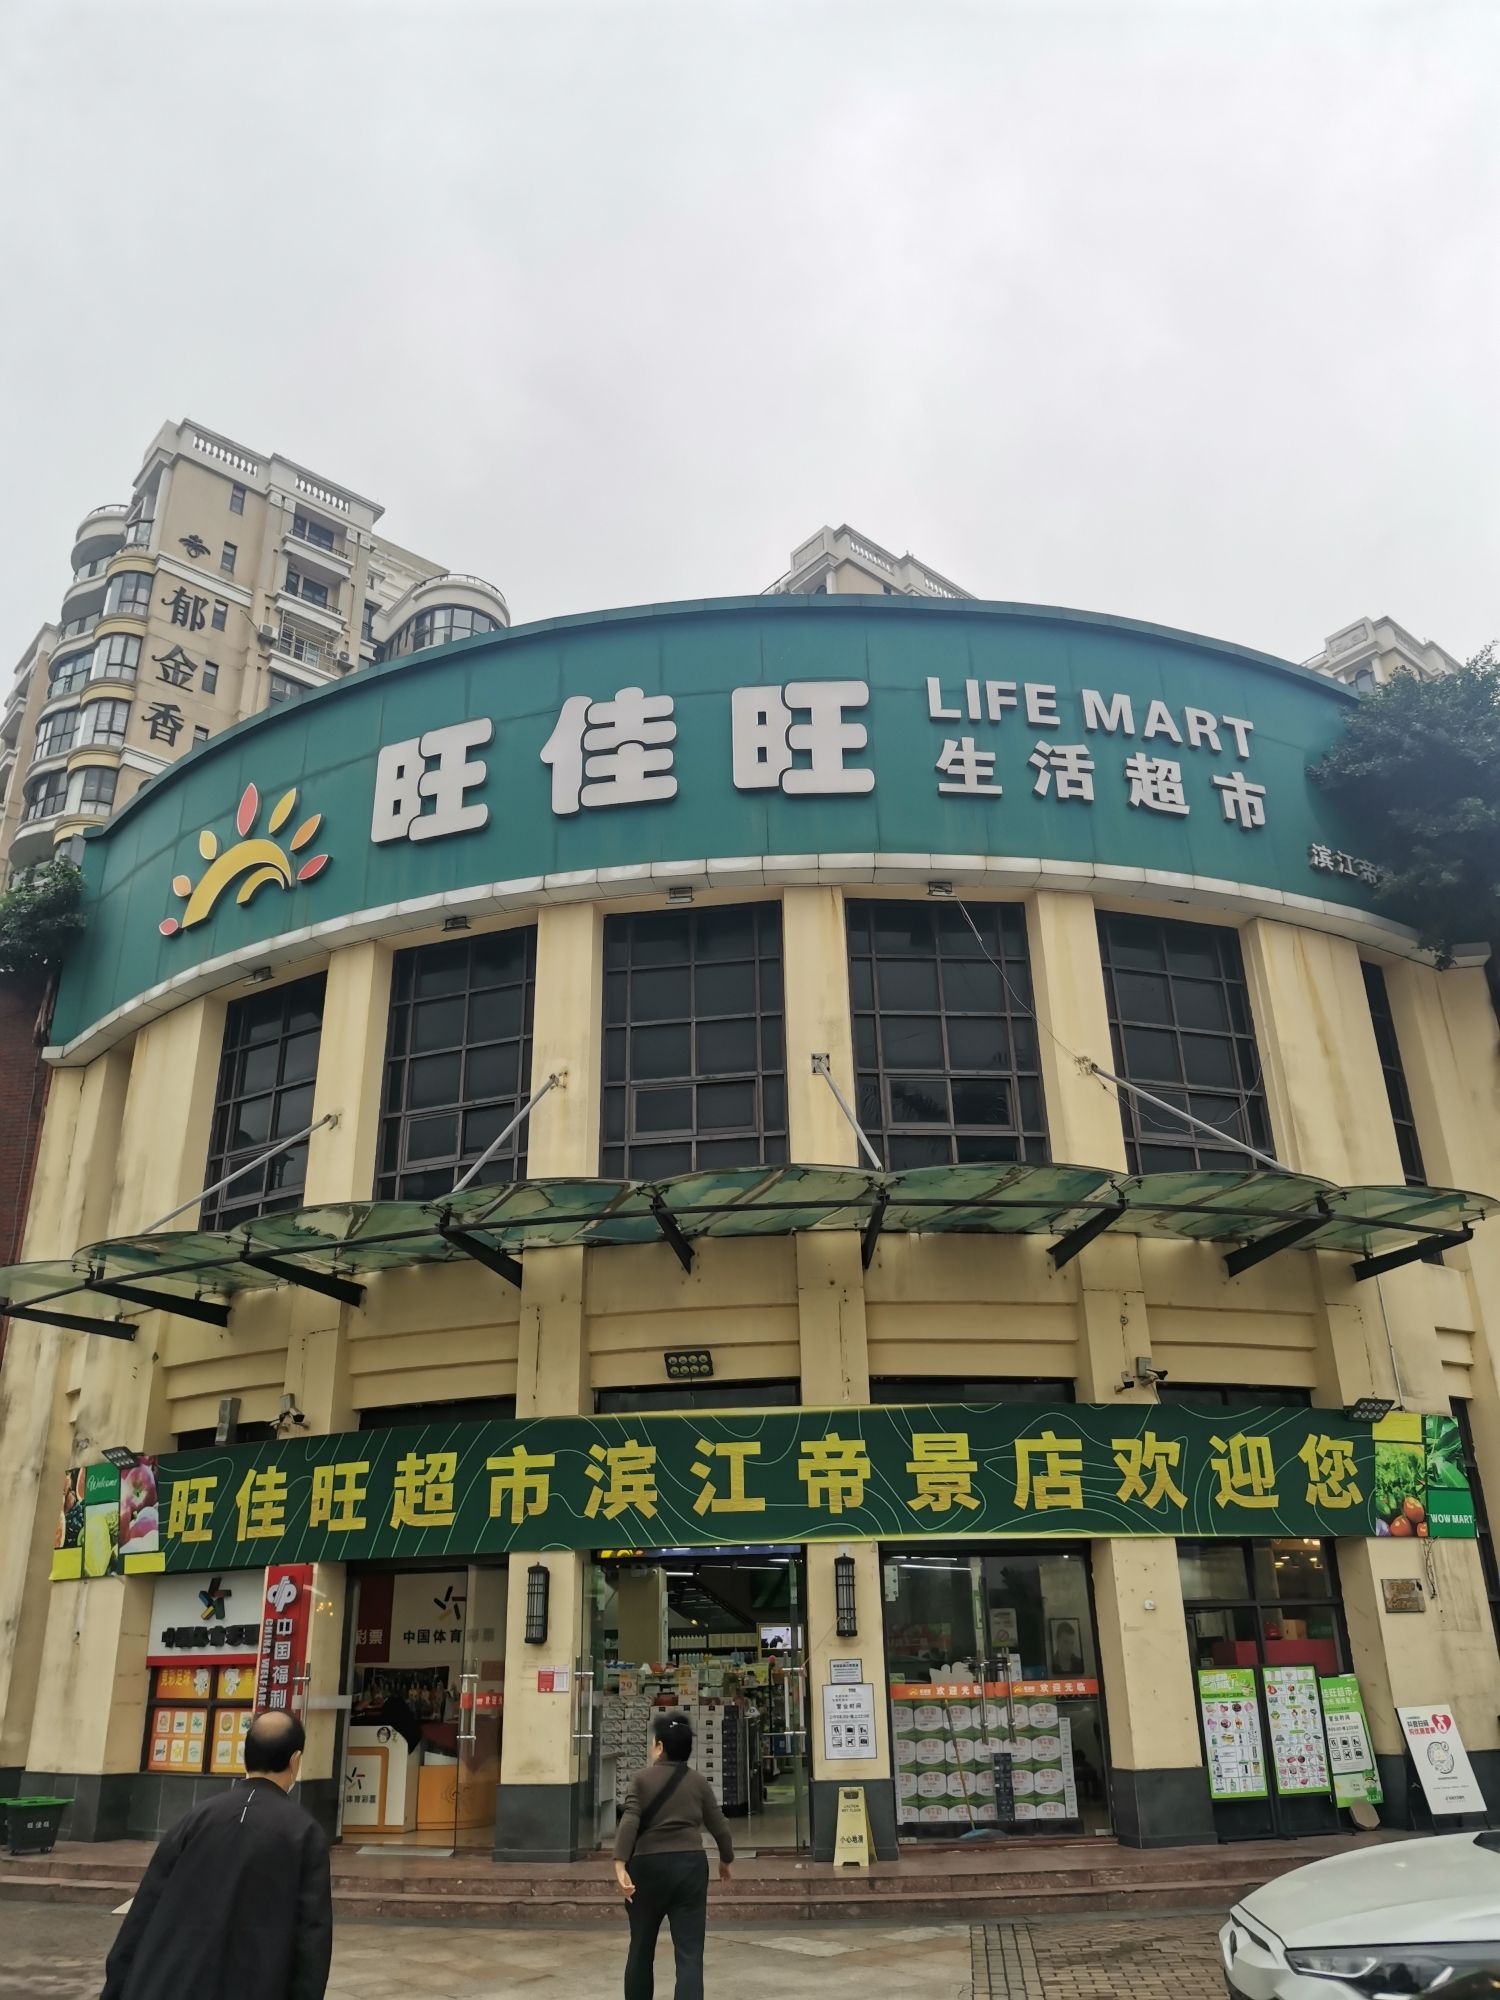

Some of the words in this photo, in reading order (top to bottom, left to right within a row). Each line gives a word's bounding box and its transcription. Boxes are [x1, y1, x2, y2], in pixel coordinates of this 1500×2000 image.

[141, 586, 209, 747] 郁金香
[926, 676, 1061, 726] LIFE
[1082, 688, 1254, 759] MART
[371, 680, 876, 843] 旺佳旺
[935, 736, 1267, 830] 生活超市
[167, 1430, 1364, 1542] 旺佳旺超市滨江帝景店欢迎您
[1430, 1513, 1450, 1523] WOW
[1451, 1514, 1473, 1523] MART
[262, 1618, 274, 1654] CHINA
[268, 1617, 294, 1709] 中国福利
[257, 1658, 270, 1706] WELFARE
[936, 1684, 983, 1697] 欢迎光临
[1039, 1681, 1086, 1694] 欢迎光临
